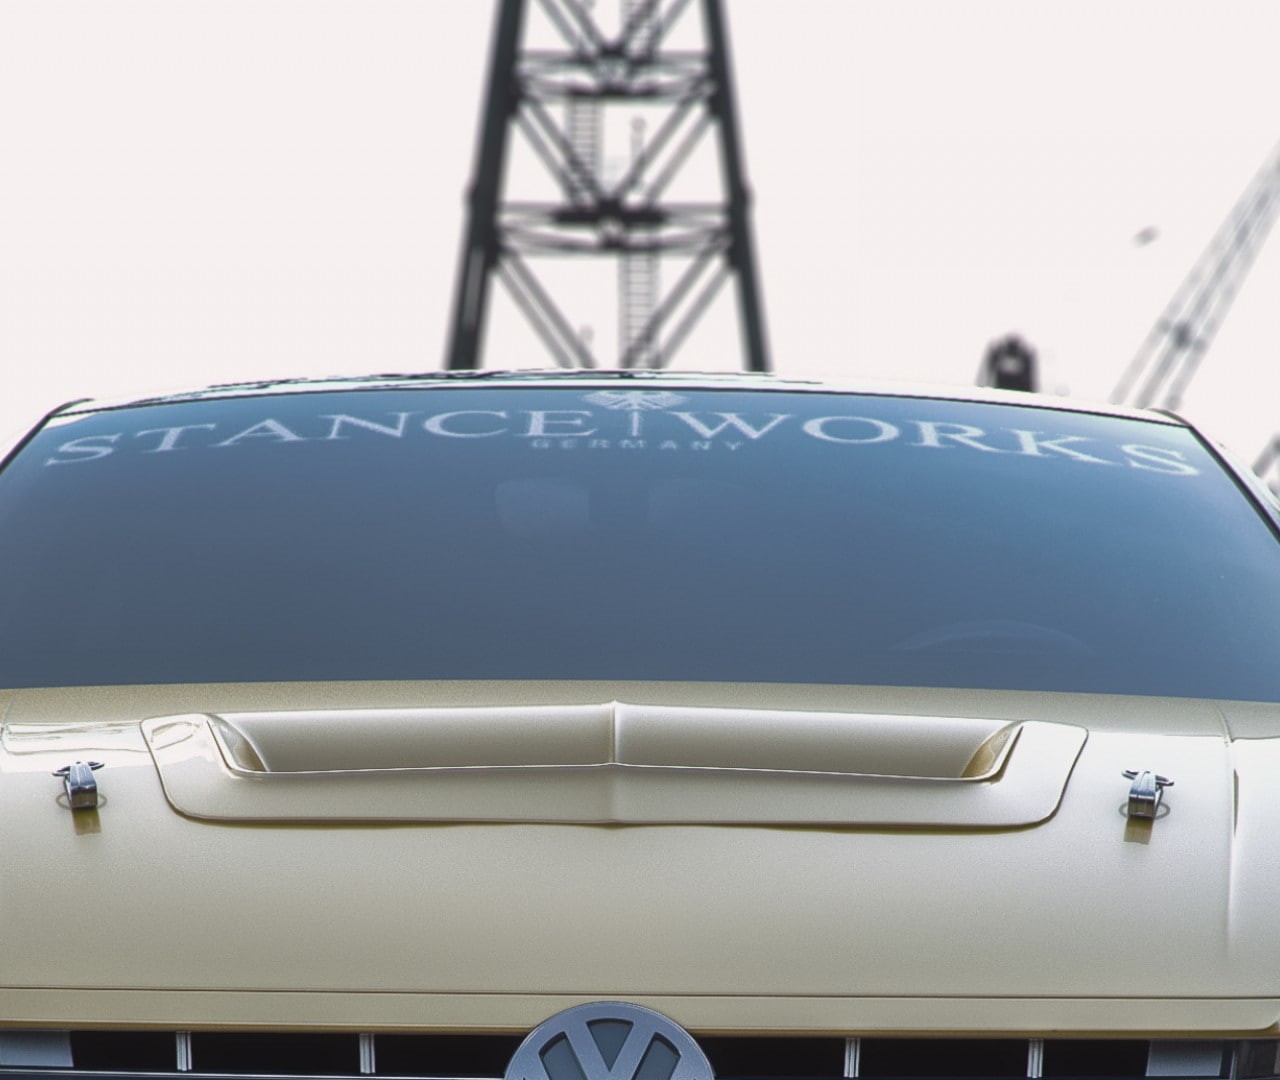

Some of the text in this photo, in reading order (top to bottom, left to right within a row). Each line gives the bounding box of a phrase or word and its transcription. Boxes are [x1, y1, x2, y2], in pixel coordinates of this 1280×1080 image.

[43, 409, 1200, 476] STANCE WORKS
[531, 438, 744, 451] GERMANY
